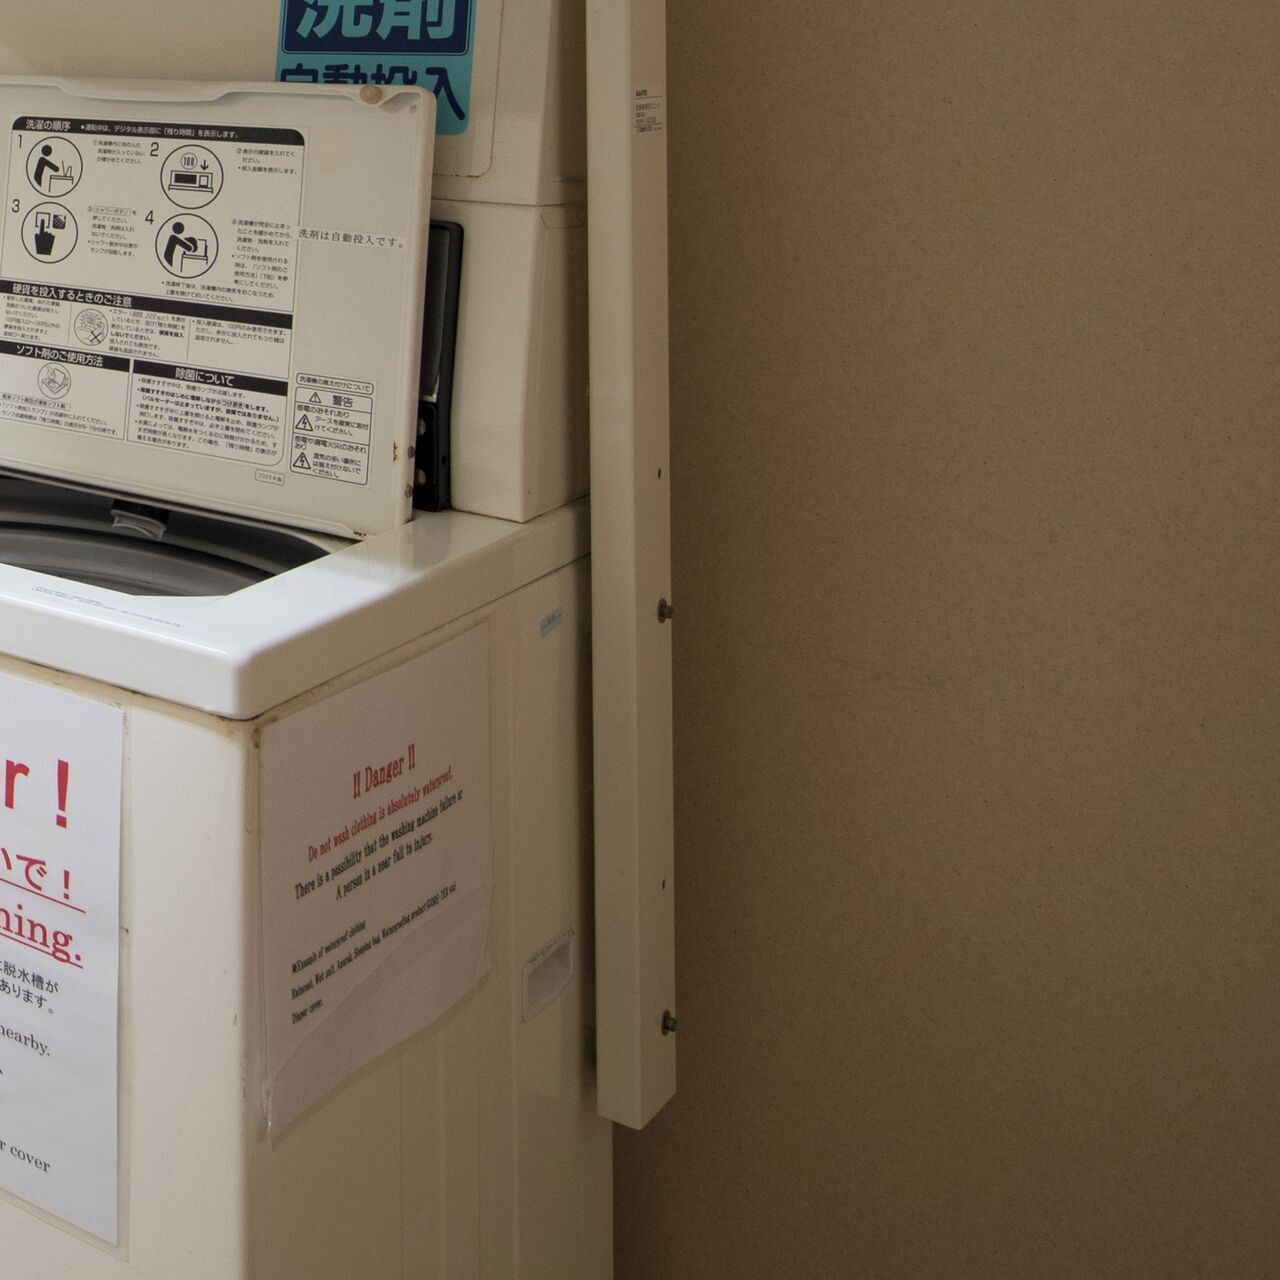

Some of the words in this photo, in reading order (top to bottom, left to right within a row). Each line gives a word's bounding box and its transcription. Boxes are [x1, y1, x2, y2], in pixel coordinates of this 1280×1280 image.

[149, 141, 160, 158] 2
[11, 198, 21, 214] 3
[144, 209, 155, 225] 4
[12, 282, 133, 308] 硬貨を投入するときのご注意
[15, 344, 104, 367] ソフト剤のご使用方法
[174, 367, 235, 388] 除菌について
[332, 394, 354, 408] 警告
[364, 755, 405, 794] Danger
[9, 1145, 51, 1173] cover
